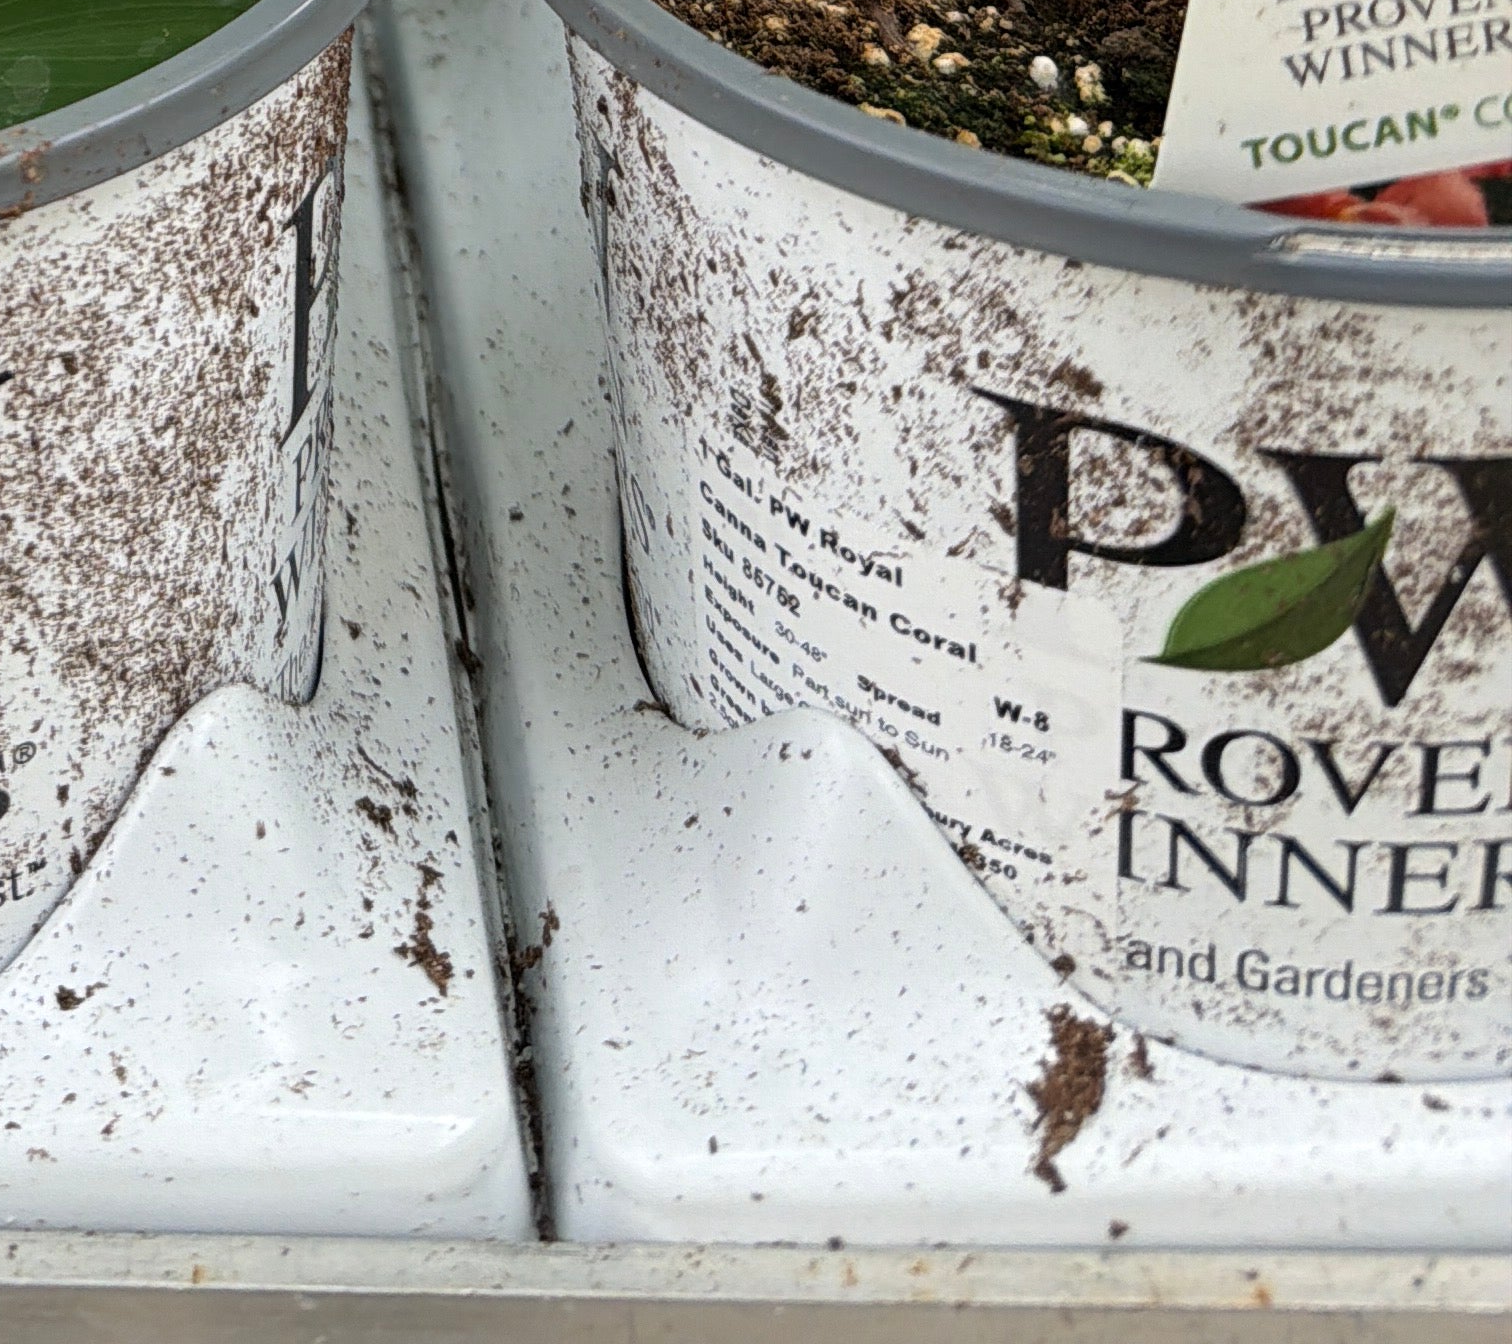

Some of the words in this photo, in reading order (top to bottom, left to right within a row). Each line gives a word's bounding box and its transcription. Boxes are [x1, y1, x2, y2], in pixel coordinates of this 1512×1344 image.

[1281, 15, 1512, 90] WINNER
[699, 480, 767, 554] Canna
[774, 542, 878, 622] Toucan
[890, 612, 977, 664] Coral
[769, 495, 810, 537] PW
[820, 528, 903, 588] Royal
[701, 516, 735, 565] Sku
[993, 695, 1050, 732] W-8
[703, 553, 755, 616] Height
[857, 674, 941, 727] Spread
[706, 614, 745, 663] Uses
[750, 659, 794, 706] Large
[704, 583, 781, 665] Exposure
[878, 716, 900, 739] to
[904, 728, 950, 762] Sun
[708, 648, 756, 706] Grown
[1121, 707, 1512, 818] ROVE
[980, 828, 1053, 865] Acres
[1236, 948, 1489, 1009] Gardeners
